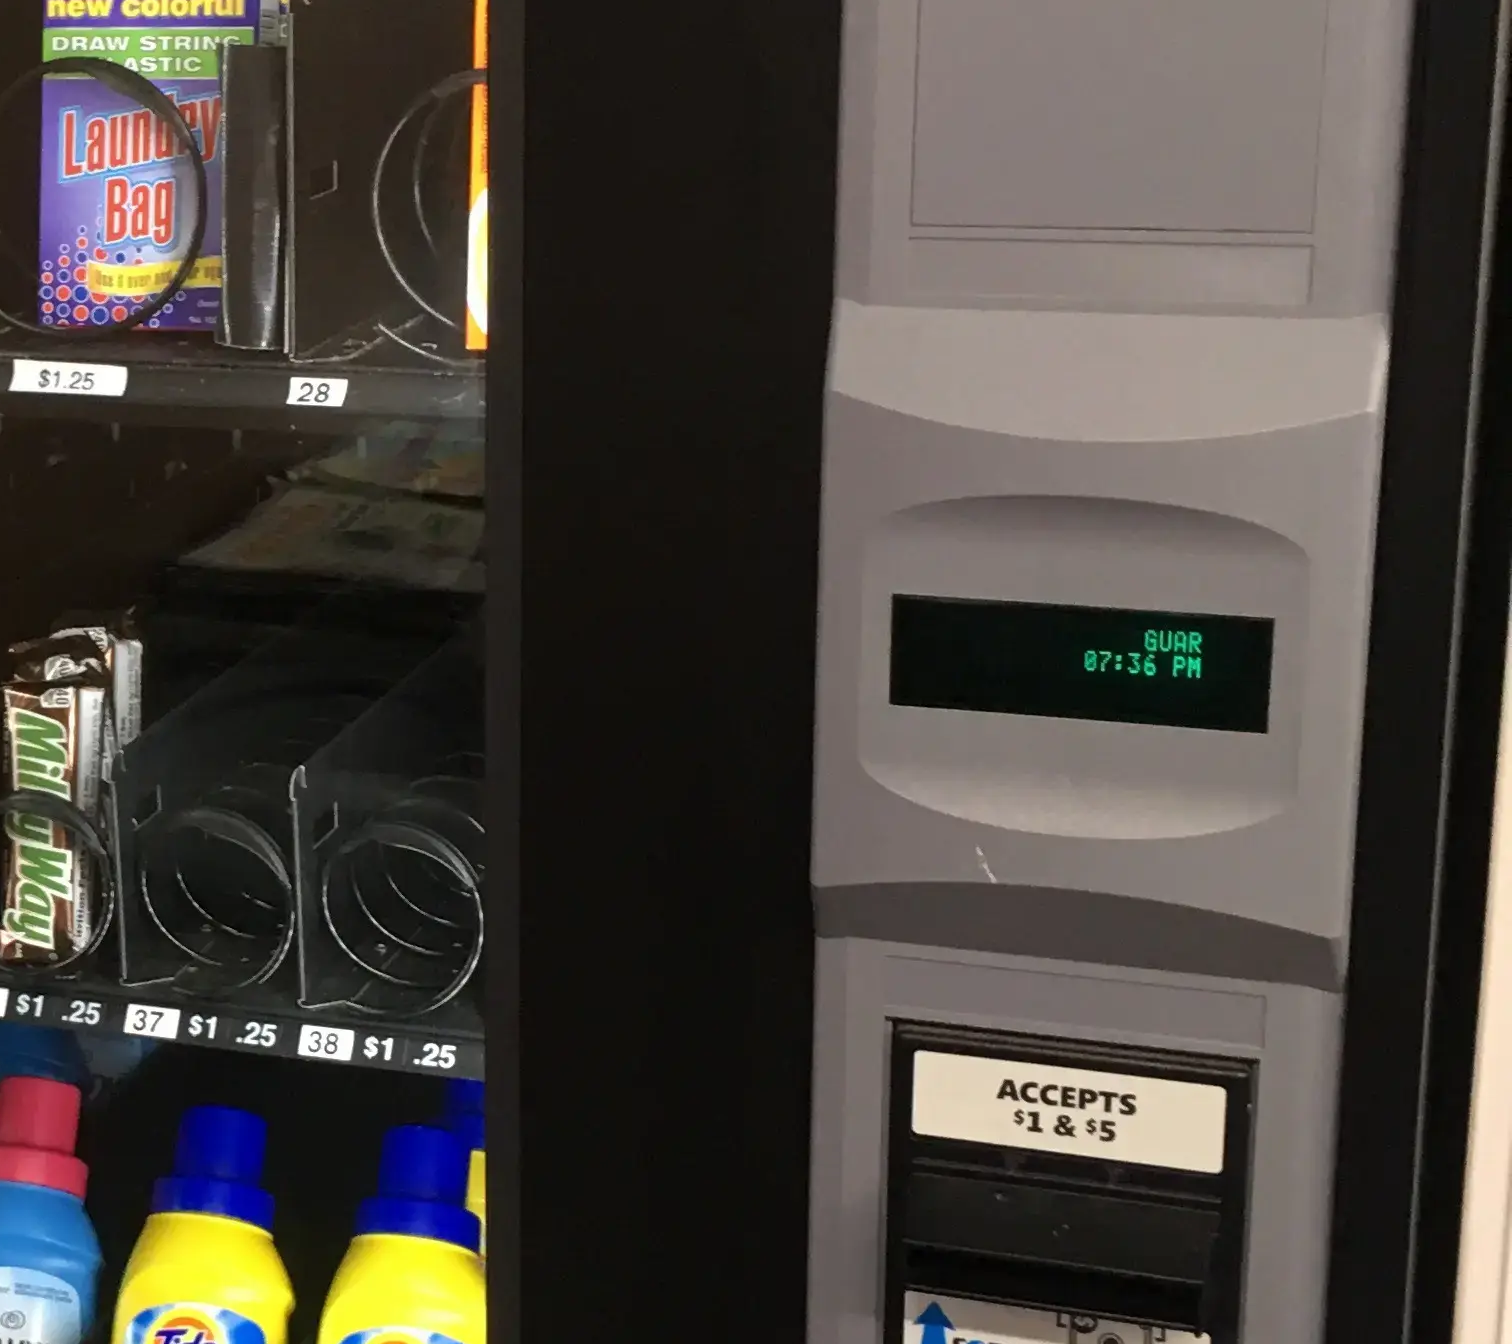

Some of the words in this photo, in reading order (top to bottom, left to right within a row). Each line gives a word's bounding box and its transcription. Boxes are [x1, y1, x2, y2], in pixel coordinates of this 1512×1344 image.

[51, 35, 130, 51] DRAW
[110, 56, 202, 72] ASTIC
[103, 177, 177, 246] Bag
[37, 369, 96, 392] $1.25
[299, 382, 330, 404] 28
[1144, 629, 1203, 654] GUAR
[1084, 650, 1157, 677] 07:36
[1172, 656, 1201, 679] PM
[4, 708, 72, 848] Mily
[3, 846, 73, 950] Way
[15, 993, 45, 1017] $1
[61, 1000, 102, 1026] .25
[132, 1009, 165, 1033] 37
[188, 1014, 218, 1040] $1
[235, 1021, 278, 1048] .25
[307, 1030, 339, 1055] 38
[363, 1035, 394, 1061] $1
[412, 1042, 457, 1069] .25
[996, 1078, 1138, 1116] ACCEPTS
[1013, 1108, 1043, 1134] $1
[1052, 1114, 1076, 1138] &
[1085, 1117, 1117, 1142] $5
